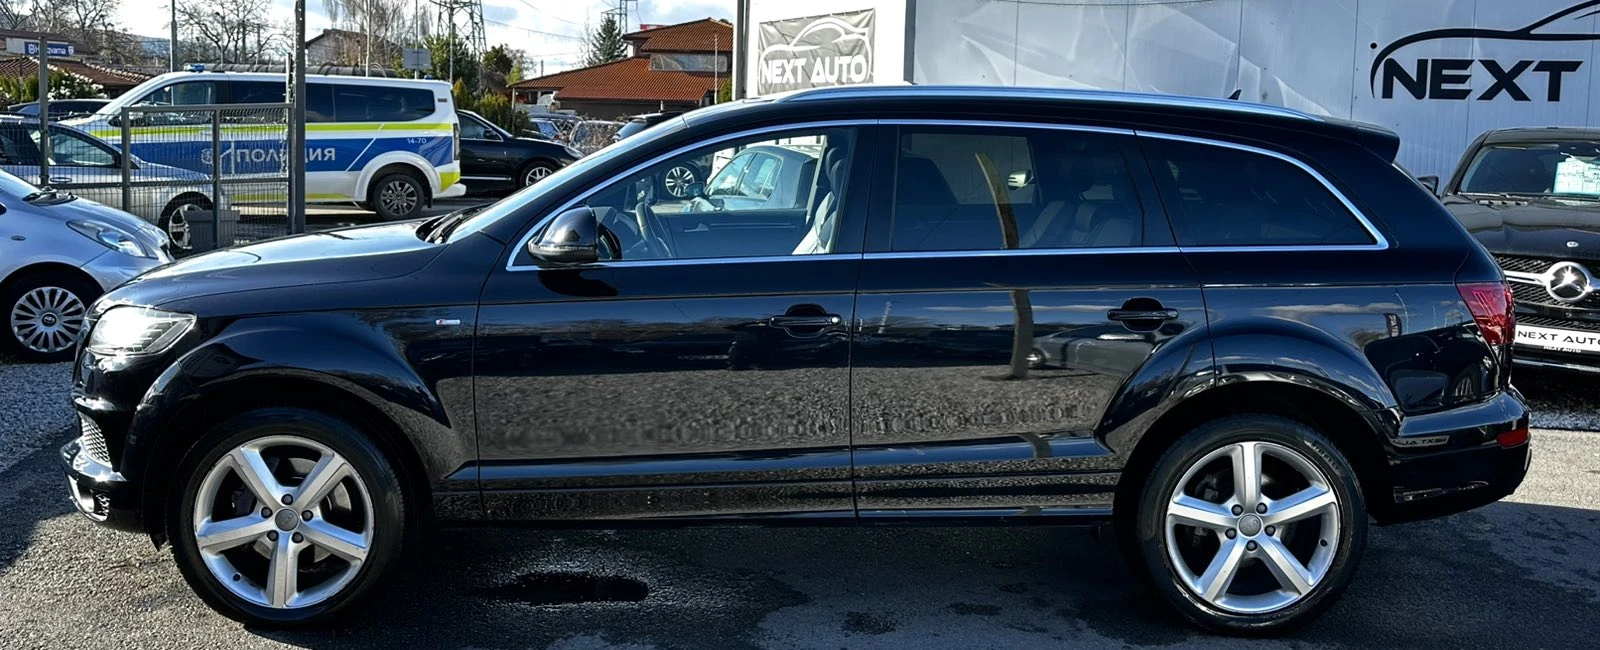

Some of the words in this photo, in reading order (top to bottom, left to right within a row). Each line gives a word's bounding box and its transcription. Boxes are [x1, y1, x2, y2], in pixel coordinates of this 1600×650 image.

[761, 58, 807, 84] NEXT
[810, 54, 868, 83] AUTO
[1382, 57, 1584, 102] NEXT
[1517, 330, 1558, 341] NEXT
